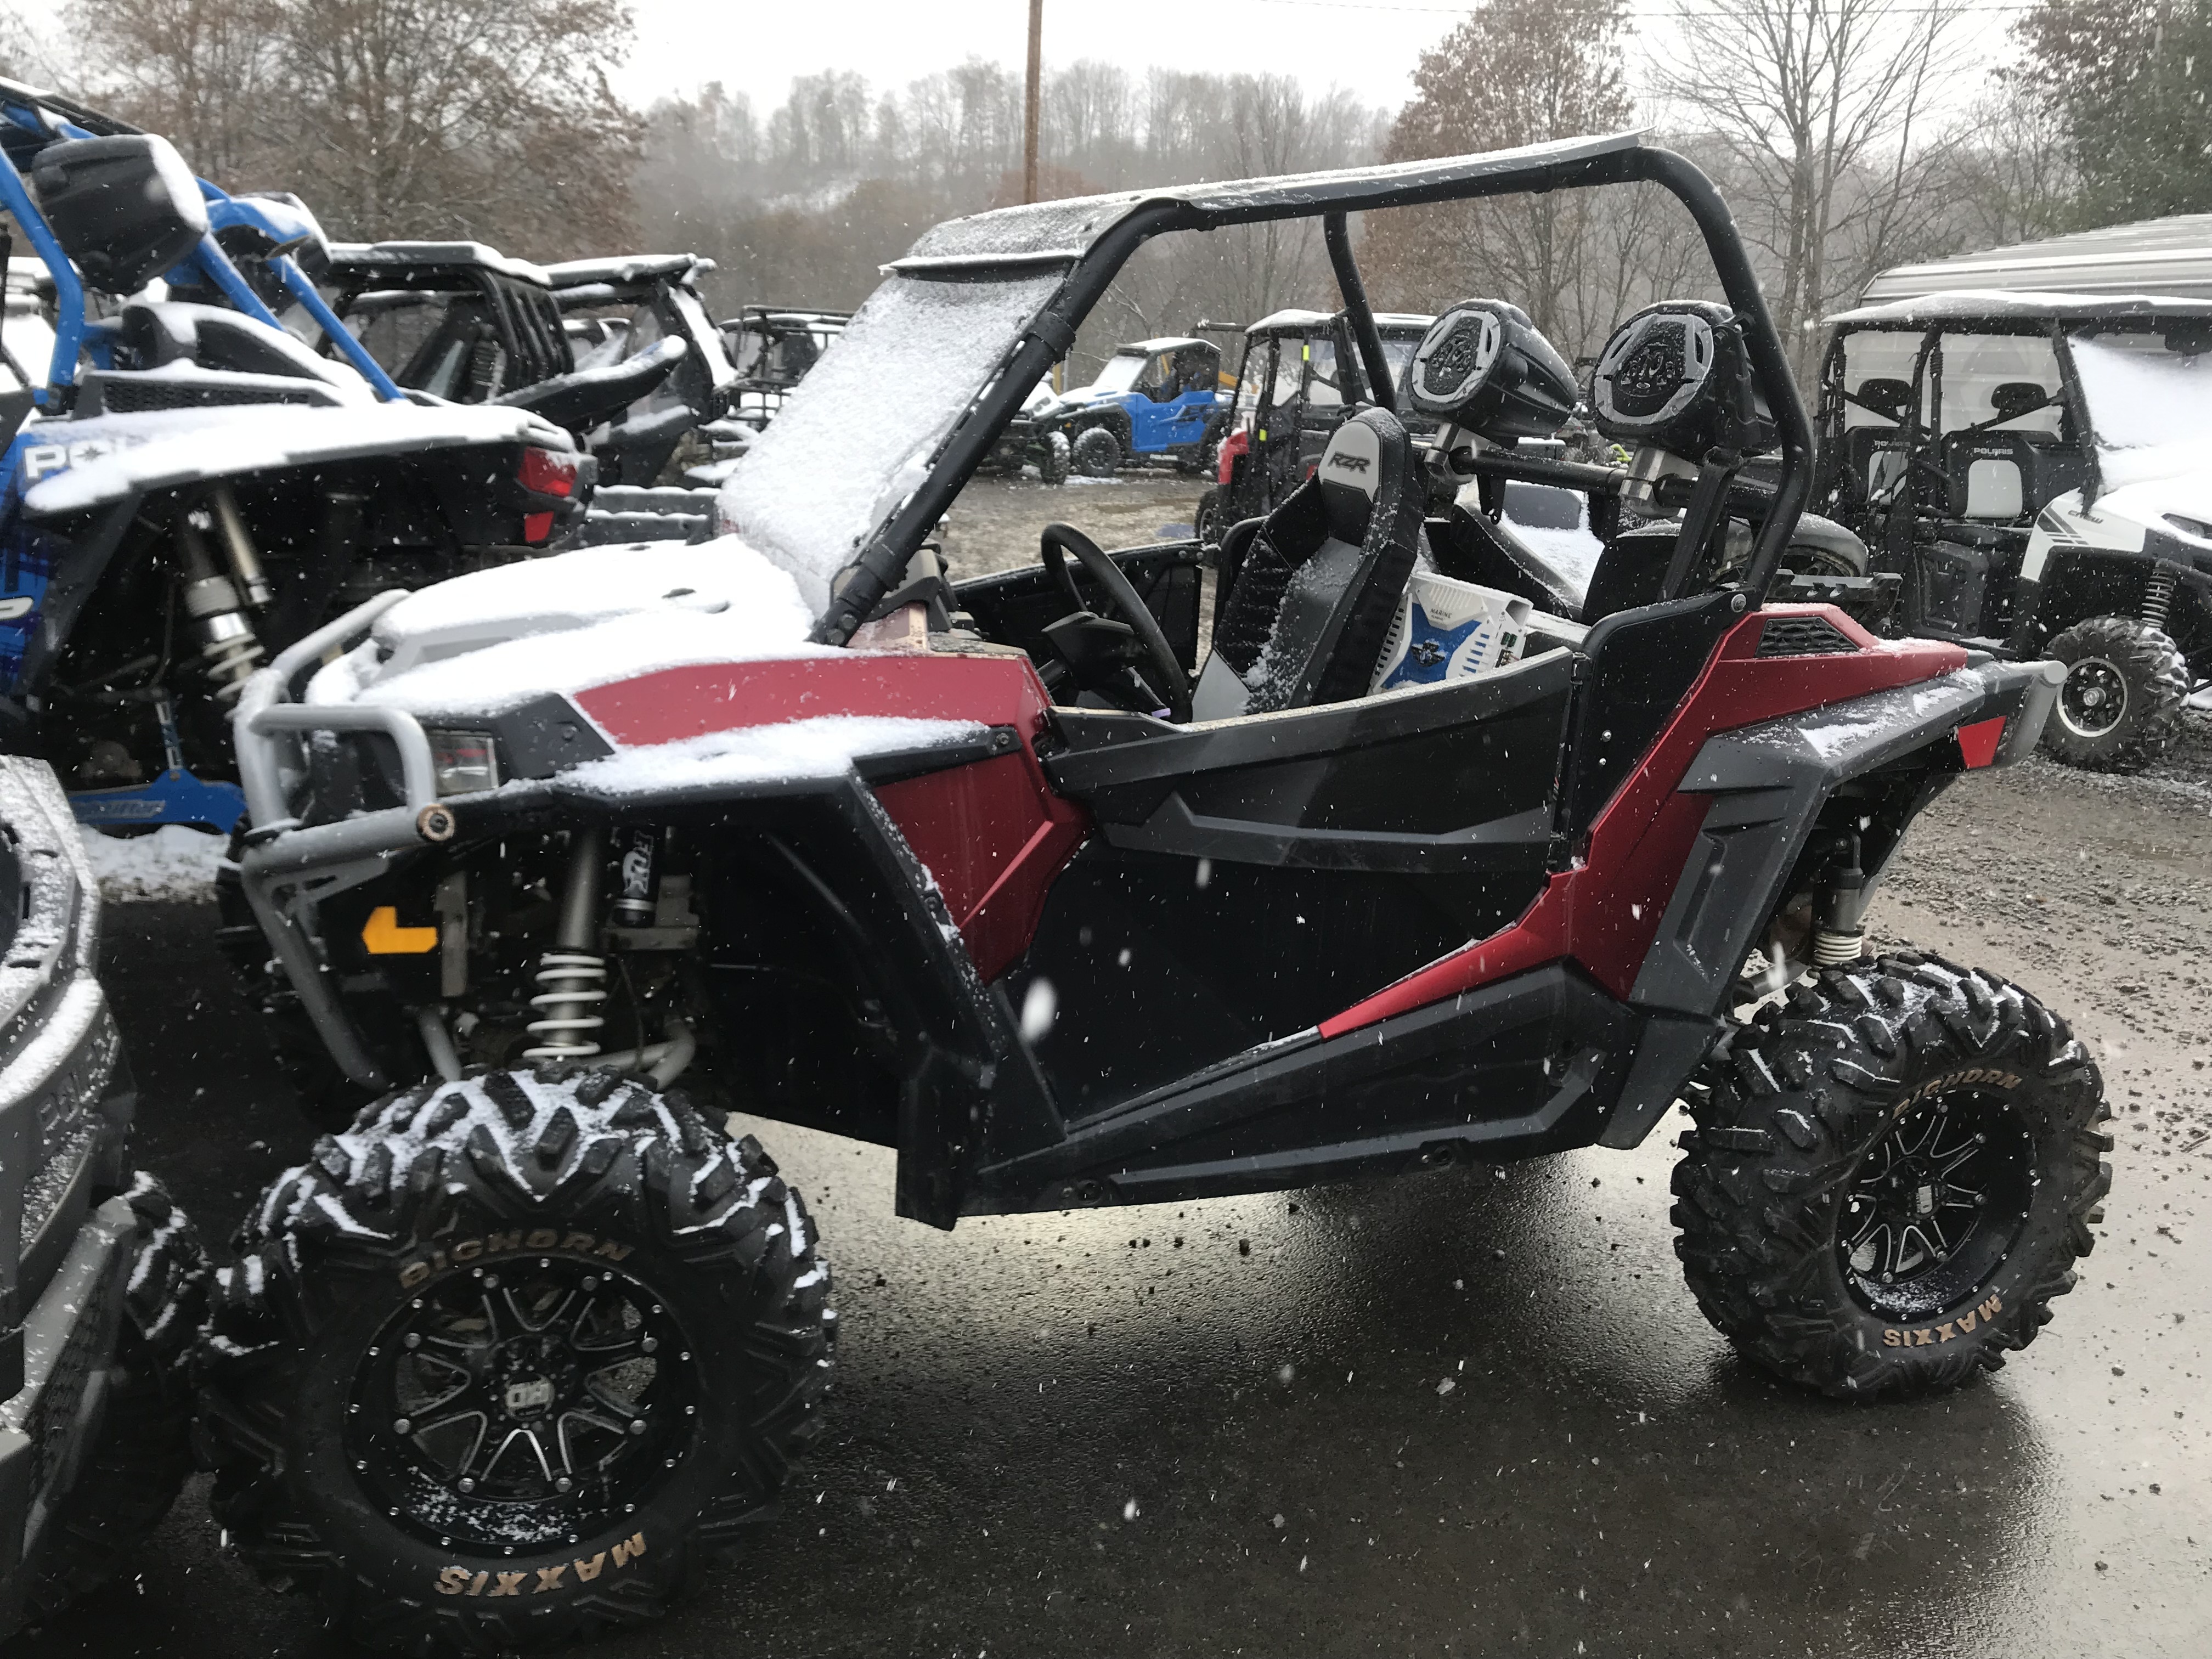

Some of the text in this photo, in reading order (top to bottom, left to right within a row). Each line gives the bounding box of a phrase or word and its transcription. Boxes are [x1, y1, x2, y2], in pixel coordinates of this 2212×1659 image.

[1328, 450, 1372, 475] RZR
[1973, 447, 2013, 455] POLARIS
[1430, 608, 1453, 619] MARINE
[1892, 1068, 2023, 1120] BIGHORN
[399, 1228, 635, 1289] BIGHORN
[1882, 1294, 2002, 1347] MAXXIS
[433, 1531, 647, 1597] MAXXIS
